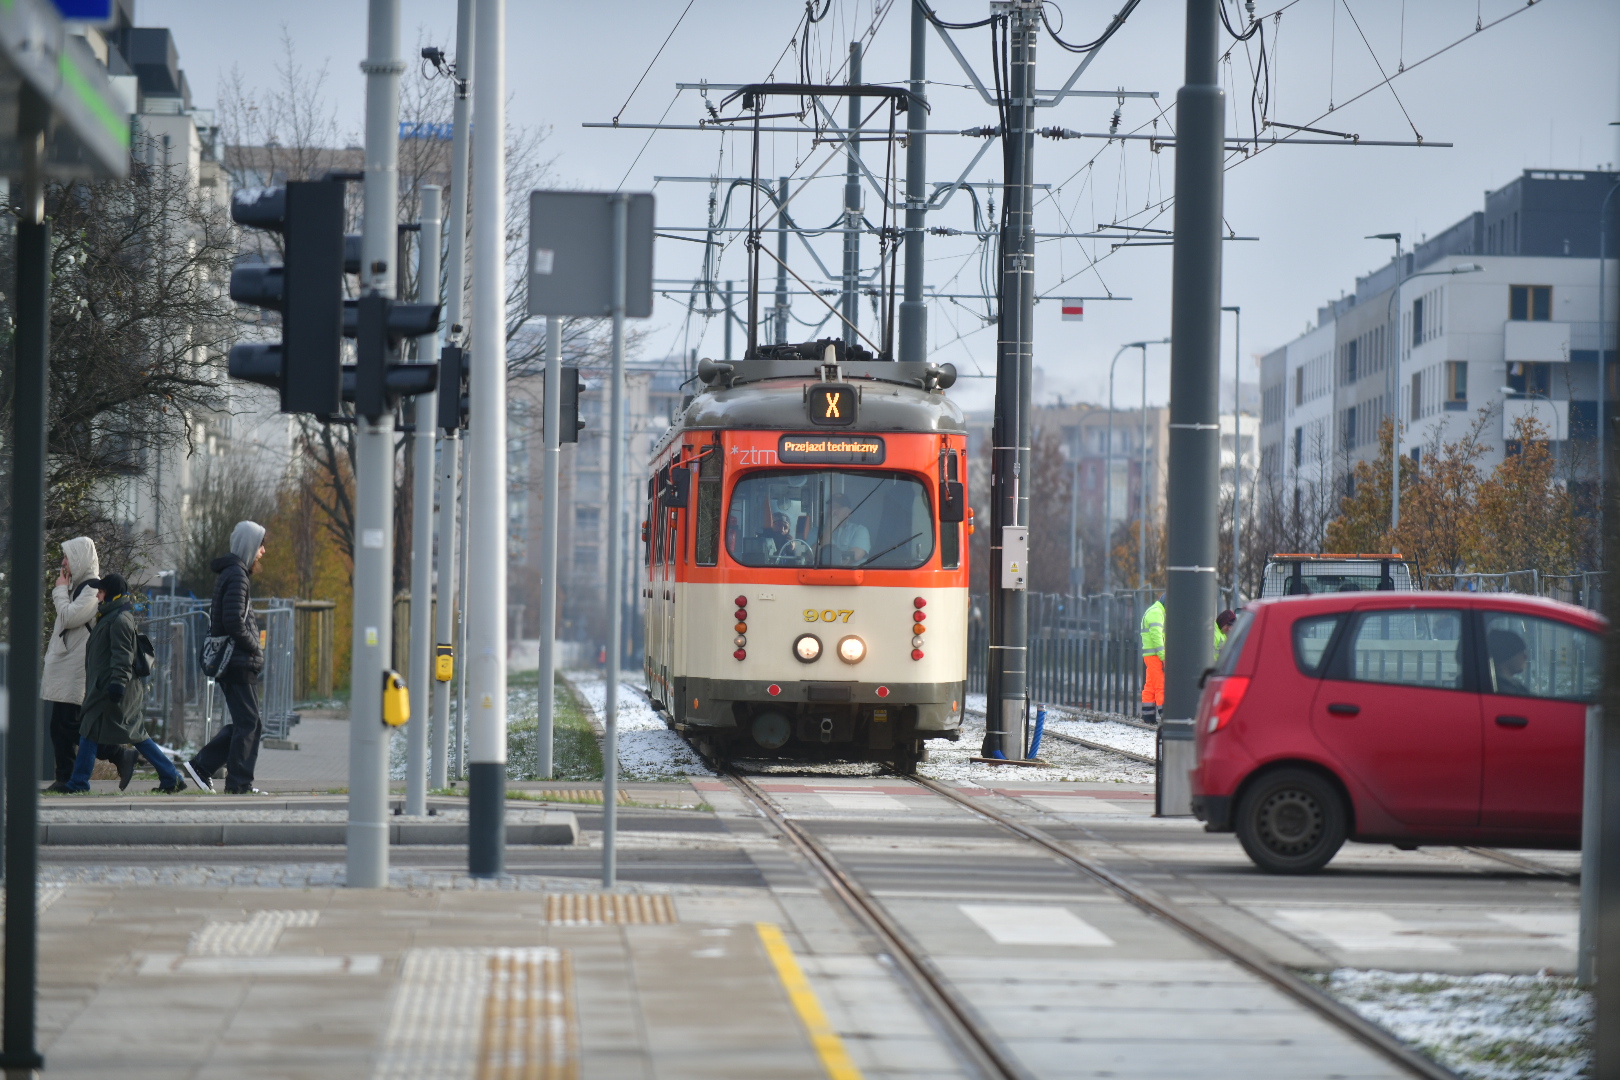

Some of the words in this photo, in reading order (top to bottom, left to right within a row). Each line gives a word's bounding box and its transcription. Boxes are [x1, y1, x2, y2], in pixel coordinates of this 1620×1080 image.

[826, 392, 840, 418] X
[784, 441, 826, 453] Przejazd
[827, 441, 879, 454] techniczny
[803, 609, 855, 623] 907
